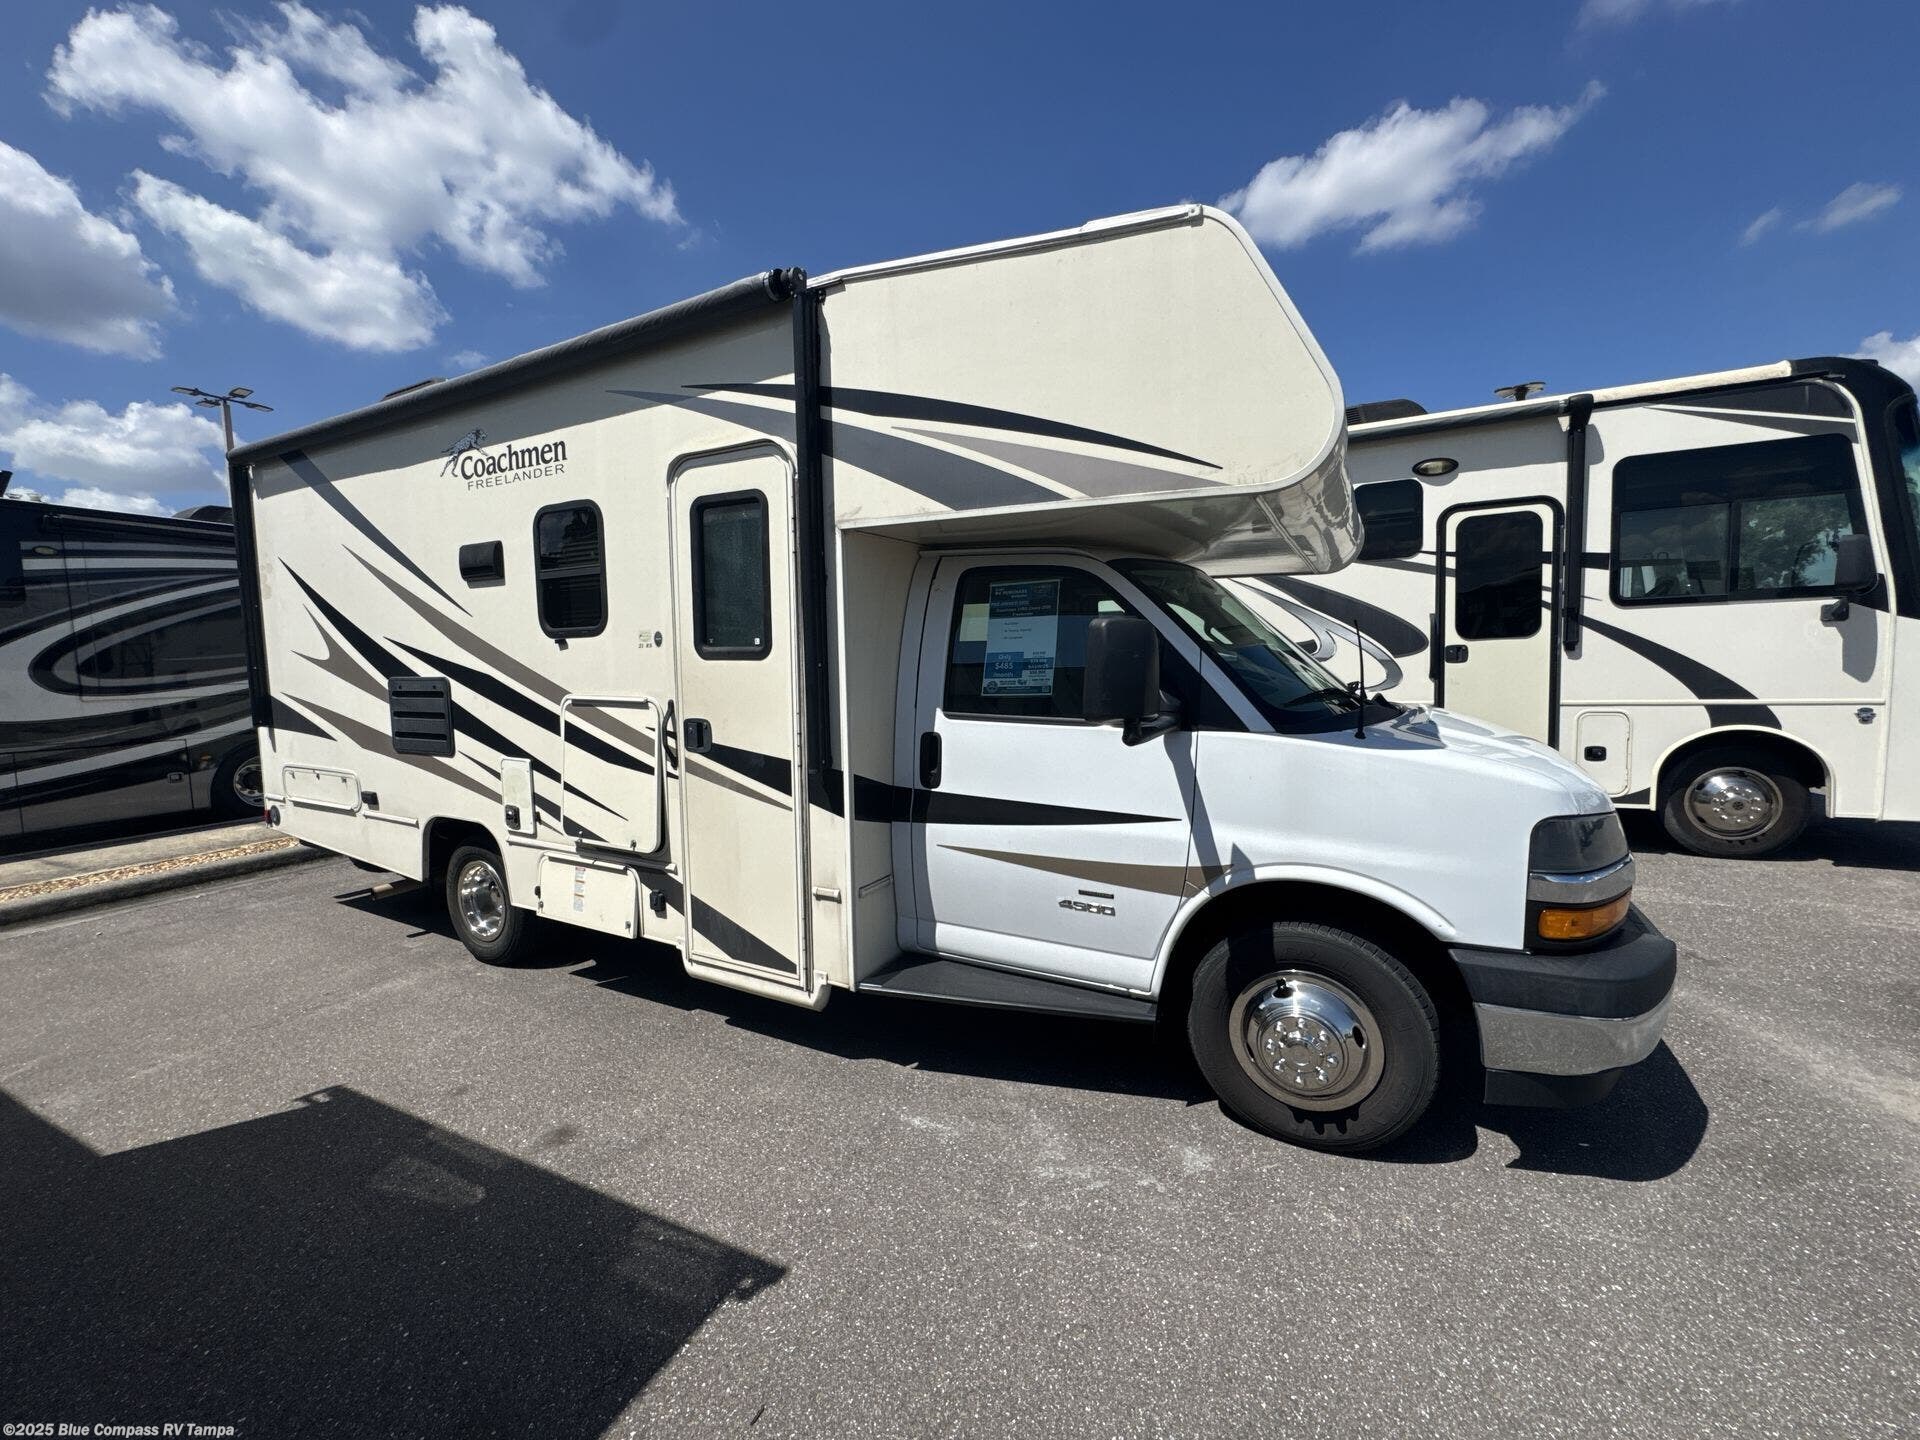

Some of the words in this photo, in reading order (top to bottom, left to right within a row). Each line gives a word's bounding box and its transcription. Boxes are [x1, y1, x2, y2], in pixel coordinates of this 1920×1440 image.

[461, 440, 568, 480] Coachmen
[467, 463, 565, 491] FREELANDER
[995, 662, 1014, 670] $485
